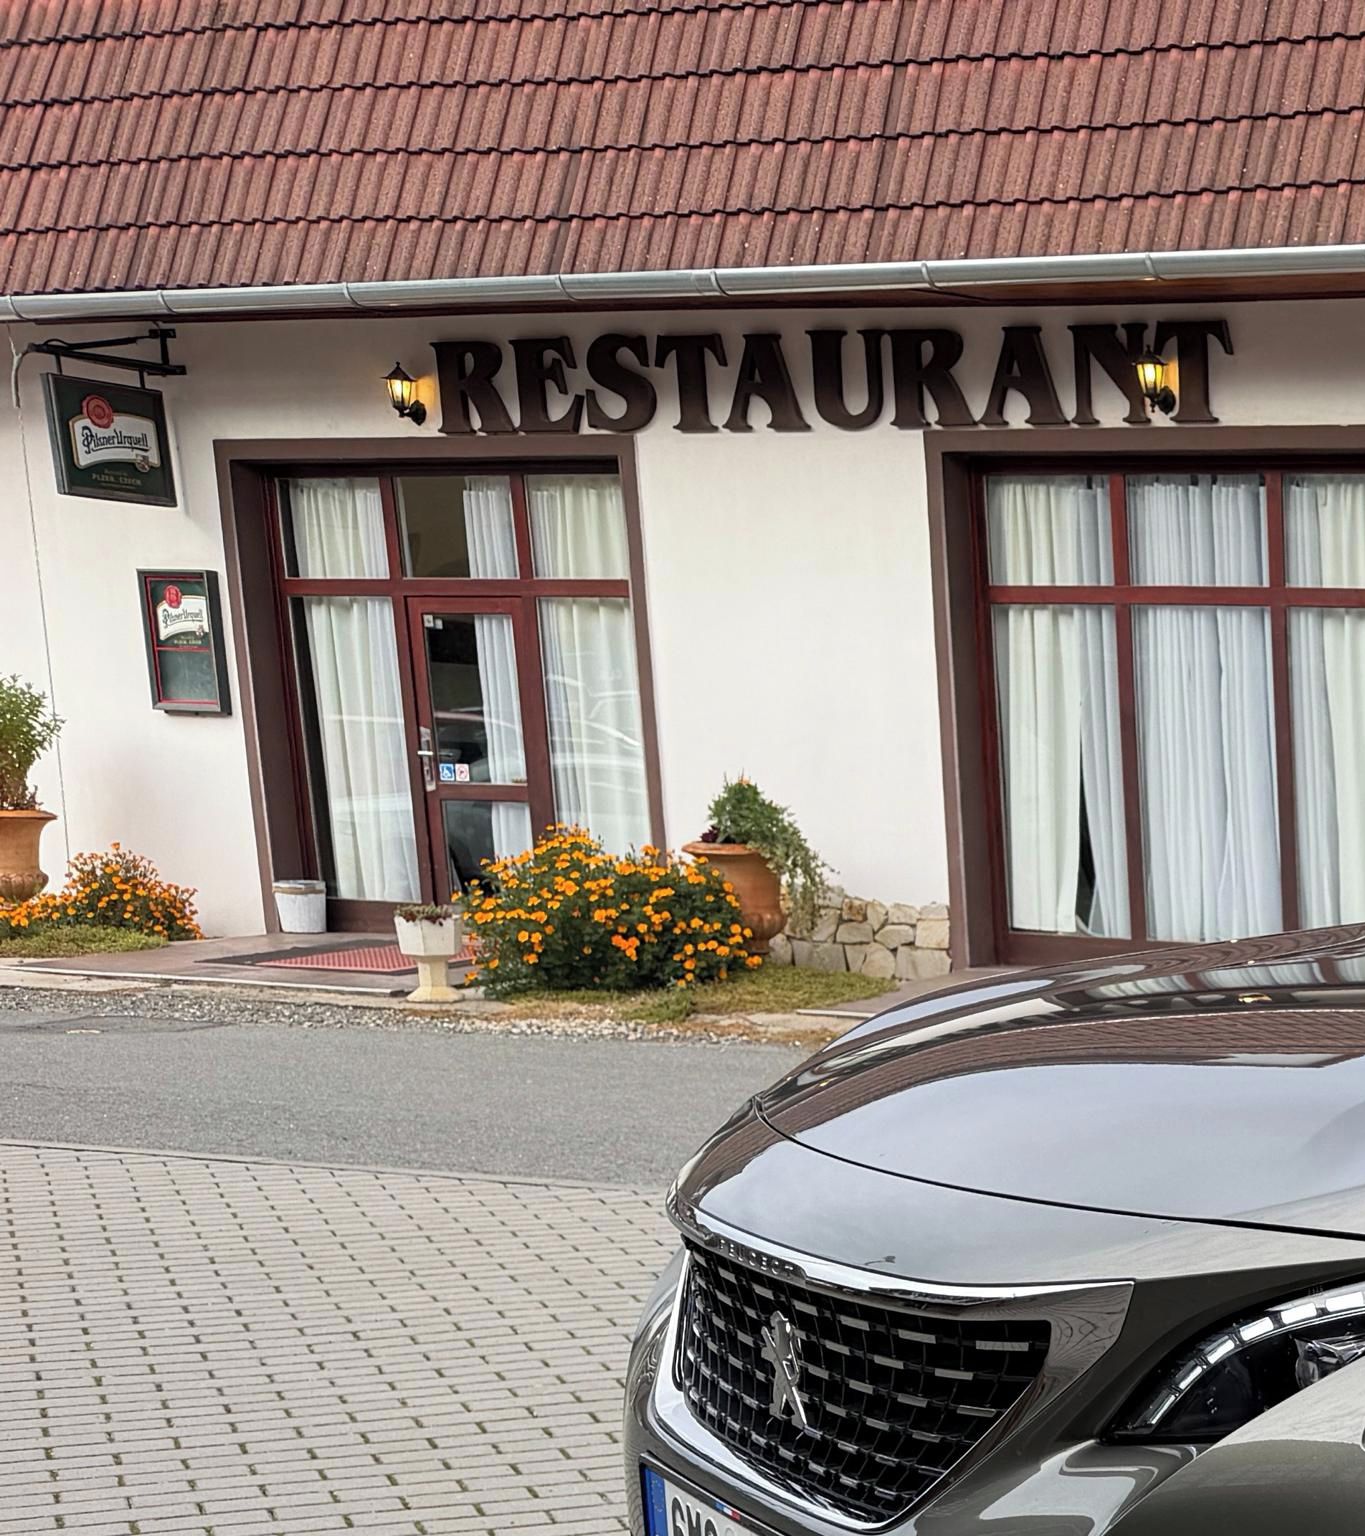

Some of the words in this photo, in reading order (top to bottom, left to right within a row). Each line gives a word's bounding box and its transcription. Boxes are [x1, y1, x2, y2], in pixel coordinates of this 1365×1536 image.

[429, 319, 1235, 434] RESTAURANT
[81, 425, 115, 455] Pilsner
[114, 428, 149, 452] Urquell
